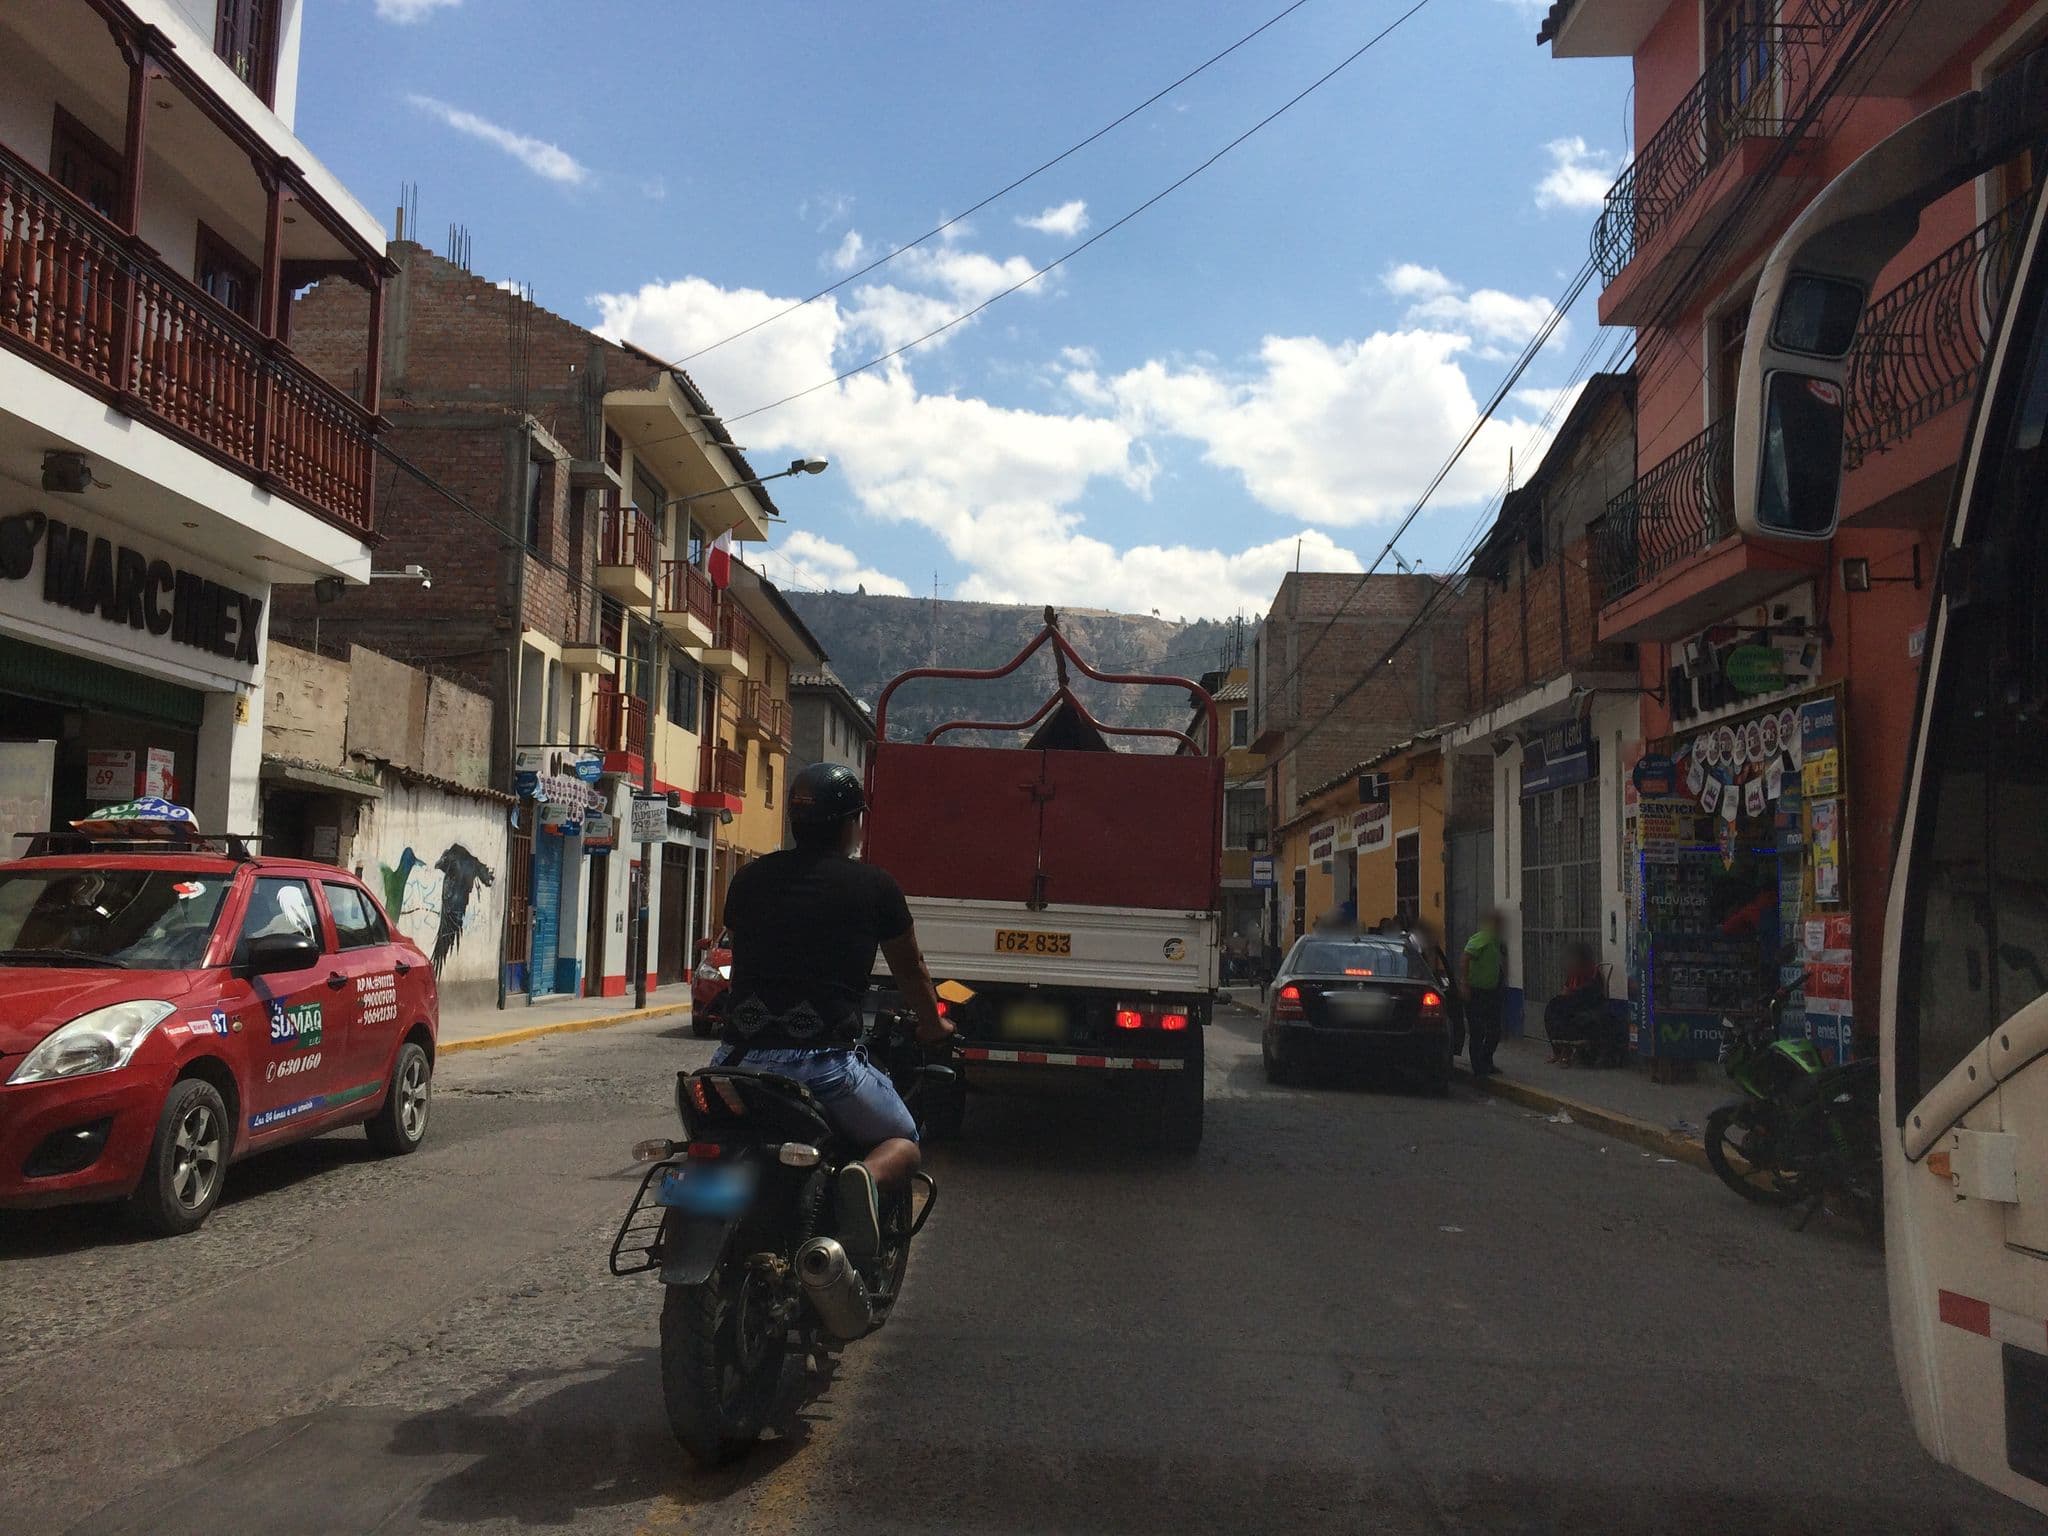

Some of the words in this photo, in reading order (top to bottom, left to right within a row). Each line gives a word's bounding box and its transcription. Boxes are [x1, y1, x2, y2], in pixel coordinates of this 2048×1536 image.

[44, 519, 262, 664] MARCIMEX
[95, 770, 114, 785] 69
[1651, 895, 1708, 906] movistar
[211, 1013, 228, 1033] 37
[271, 1010, 322, 1039] SUMAQ
[277, 1053, 321, 1077] 630160
